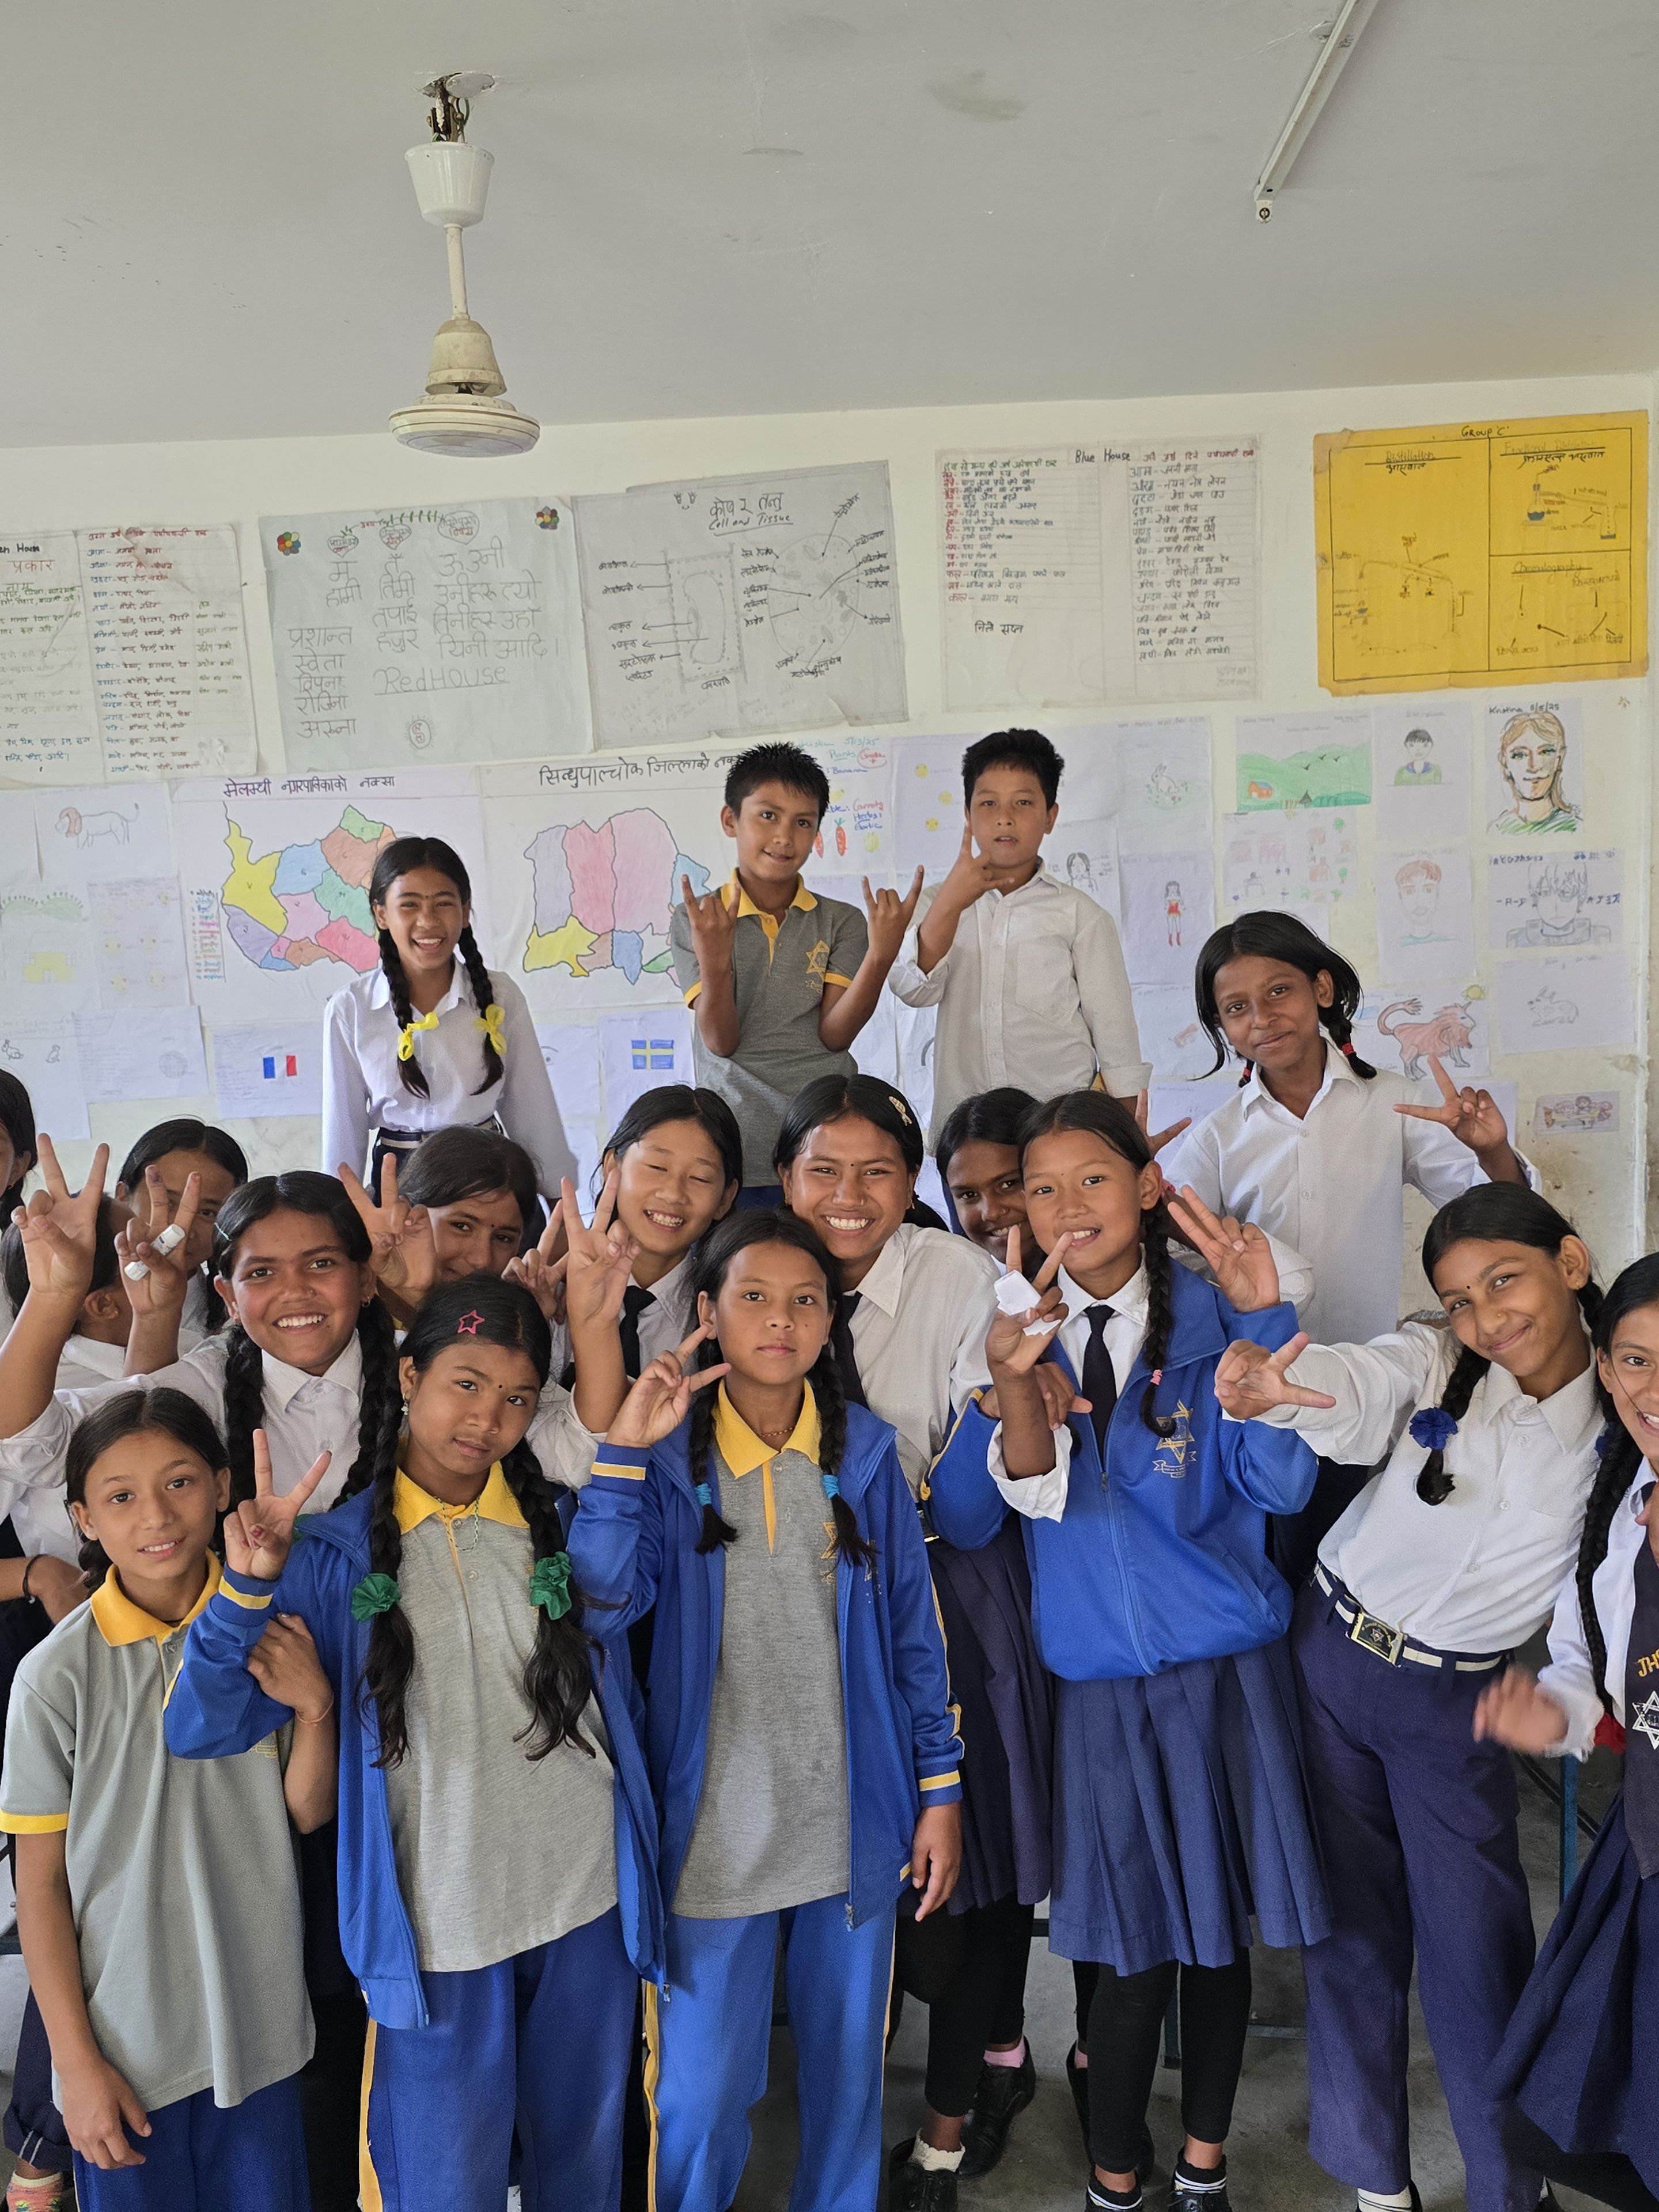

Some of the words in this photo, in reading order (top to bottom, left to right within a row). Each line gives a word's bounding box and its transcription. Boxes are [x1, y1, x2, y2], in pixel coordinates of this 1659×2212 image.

[1075, 449, 1095, 463] Blue
[1104, 448, 1131, 461] House
[16, 542, 40, 553] House
[465, 535, 505, 573] उनी
[7, 559, 55, 574] प्रकार
[3, 582, 35, 592] नाम
[326, 577, 362, 608] हामी
[379, 571, 416, 601] तिमी
[287, 627, 353, 649] प्रशान्त
